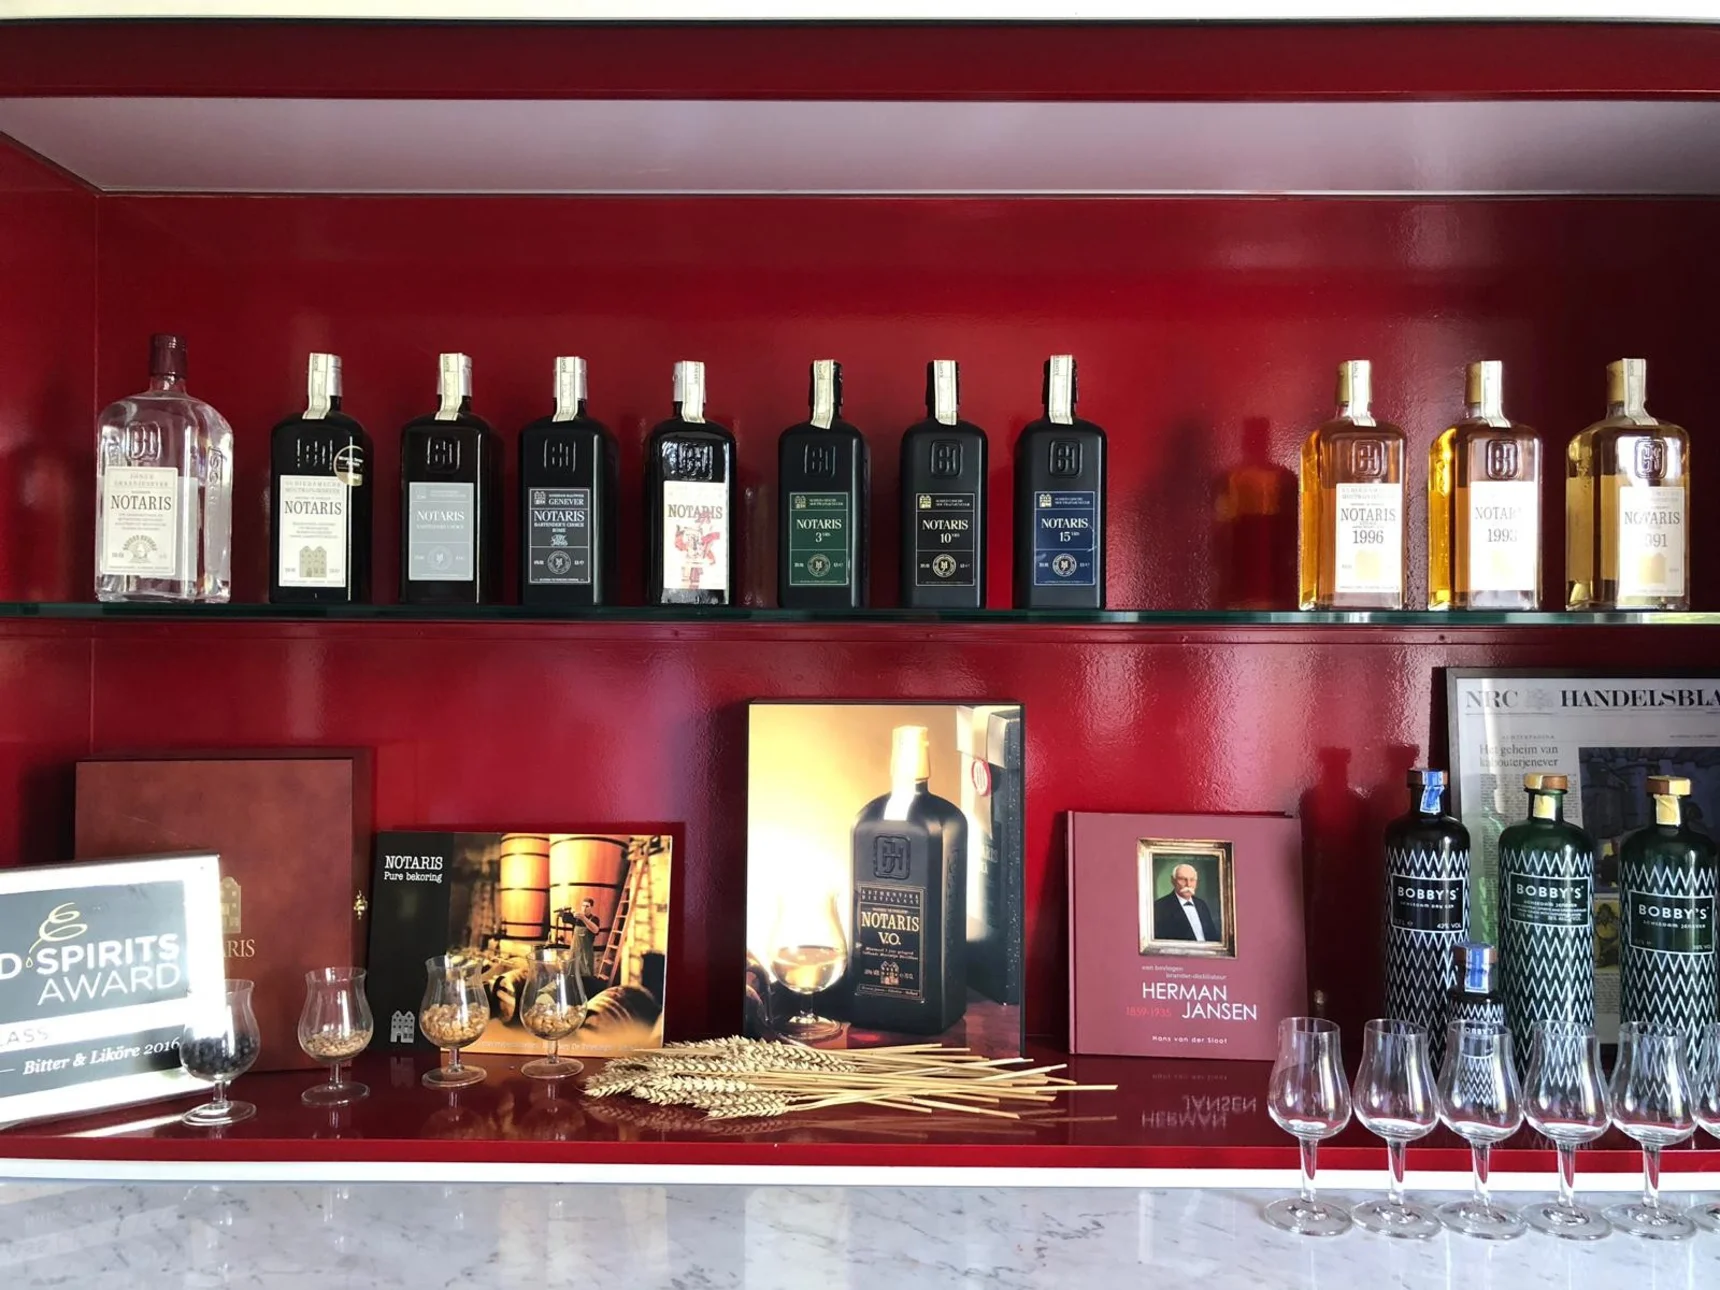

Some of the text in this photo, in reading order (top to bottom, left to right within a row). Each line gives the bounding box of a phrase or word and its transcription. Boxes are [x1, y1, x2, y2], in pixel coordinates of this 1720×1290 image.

[110, 494, 172, 511] NOTARIS
[284, 500, 342, 515] NOTARIS
[548, 498, 584, 506] GENEVER
[416, 510, 465, 521] NOTARIS
[533, 510, 585, 522] NOTARIS
[667, 504, 723, 519] NOTARIS
[1340, 507, 1396, 521] NOTARIS
[1475, 506, 1521, 520] NOTAR
[1624, 511, 1680, 525] NOTARIS
[796, 519, 842, 530] NOTARIS
[922, 519, 969, 530] NOTARIS
[1041, 518, 1089, 529] NOTARIS
[815, 532, 822, 543] 3
[940, 533, 952, 543] 10
[1060, 531, 1071, 542] 15
[1352, 529, 1384, 544] 1996
[1466, 689, 1518, 708] NRC
[1500, 743, 1538, 757] geheim
[1540, 746, 1559, 755] van
[384, 855, 443, 870] NOTARIS
[384, 871, 443, 884] Pure bekoring
[1397, 886, 1458, 900] BOBBY'S
[1516, 883, 1582, 899] BOBBY'S
[1638, 904, 1708, 920] BOBBY'S
[861, 911, 920, 932] NOTARIS
[36, 933, 180, 975] SPIRITS
[225, 938, 256, 958] RIS
[37, 963, 181, 1006] AWARD
[1142, 981, 1227, 1001] HERMAN
[1181, 1001, 1257, 1021] JANSEN
[23, 1037, 180, 1076] Bitter & Liköre 2016
